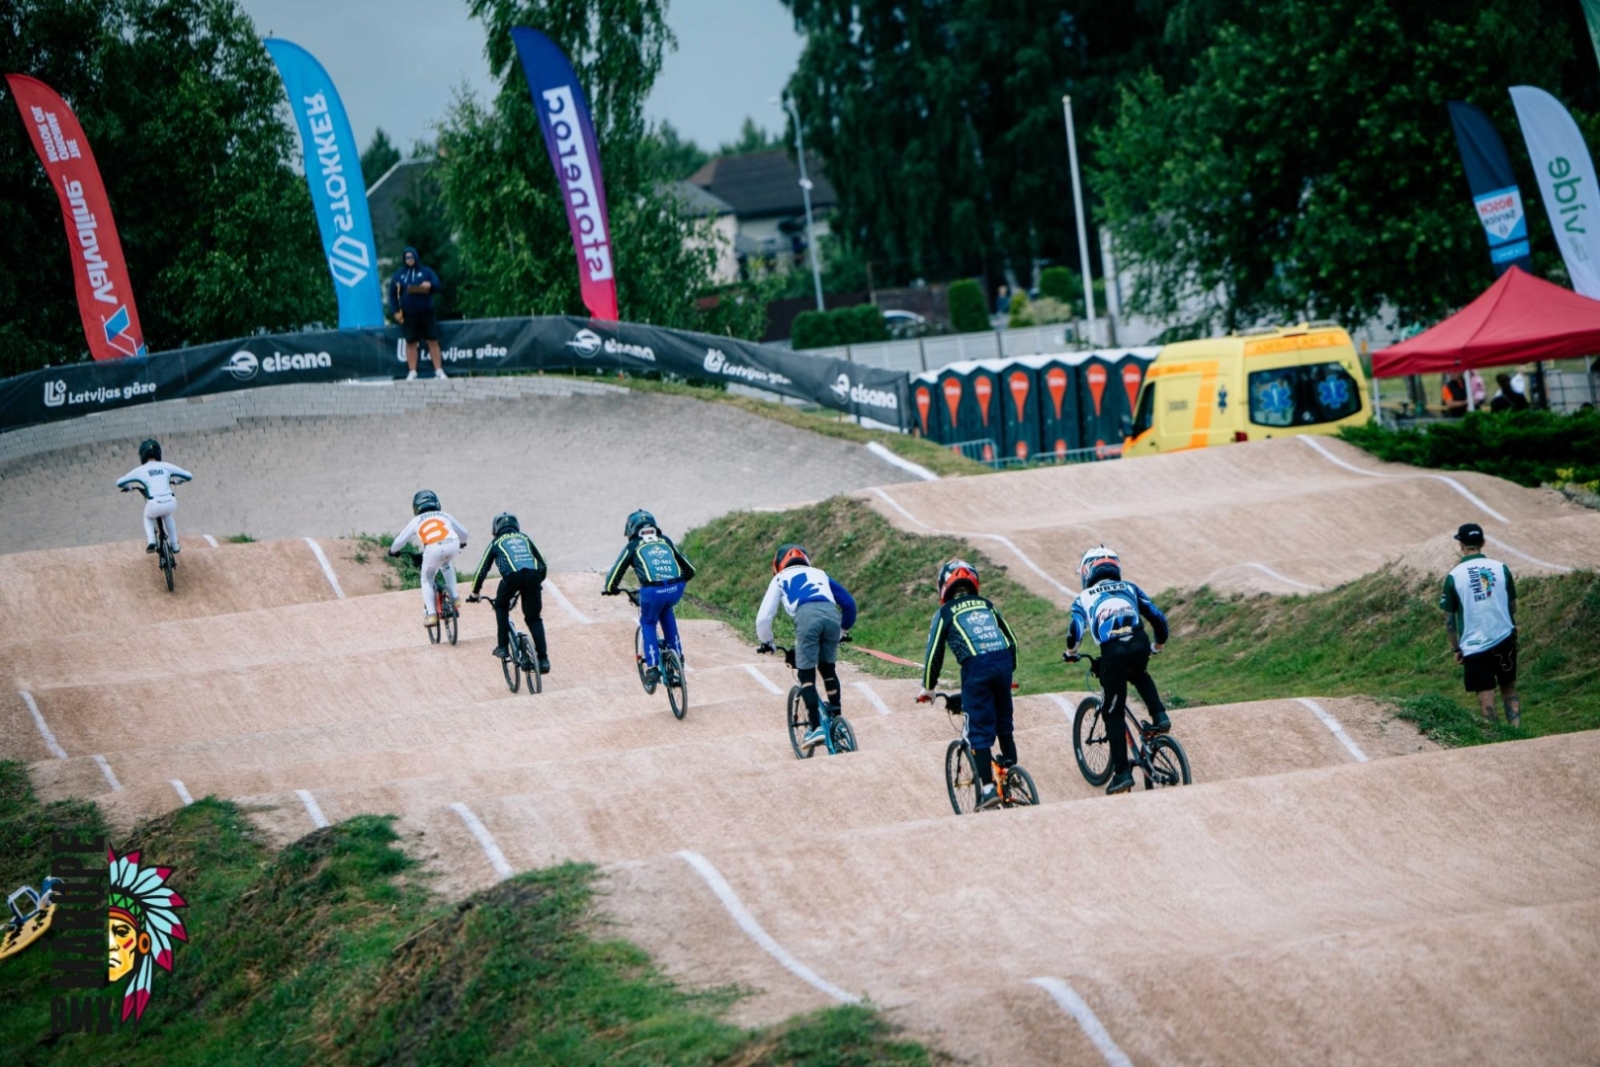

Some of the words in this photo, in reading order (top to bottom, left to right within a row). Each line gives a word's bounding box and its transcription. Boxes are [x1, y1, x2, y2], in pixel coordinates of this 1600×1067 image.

[475, 343, 508, 360] gāze
[262, 351, 332, 373] elsana
[68, 386, 121, 404] Latvijas
[123, 381, 156, 396] gāze
[850, 383, 898, 410] elsana
[1088, 583, 1126, 596] KURTS
[978, 632, 998, 640] VASS
